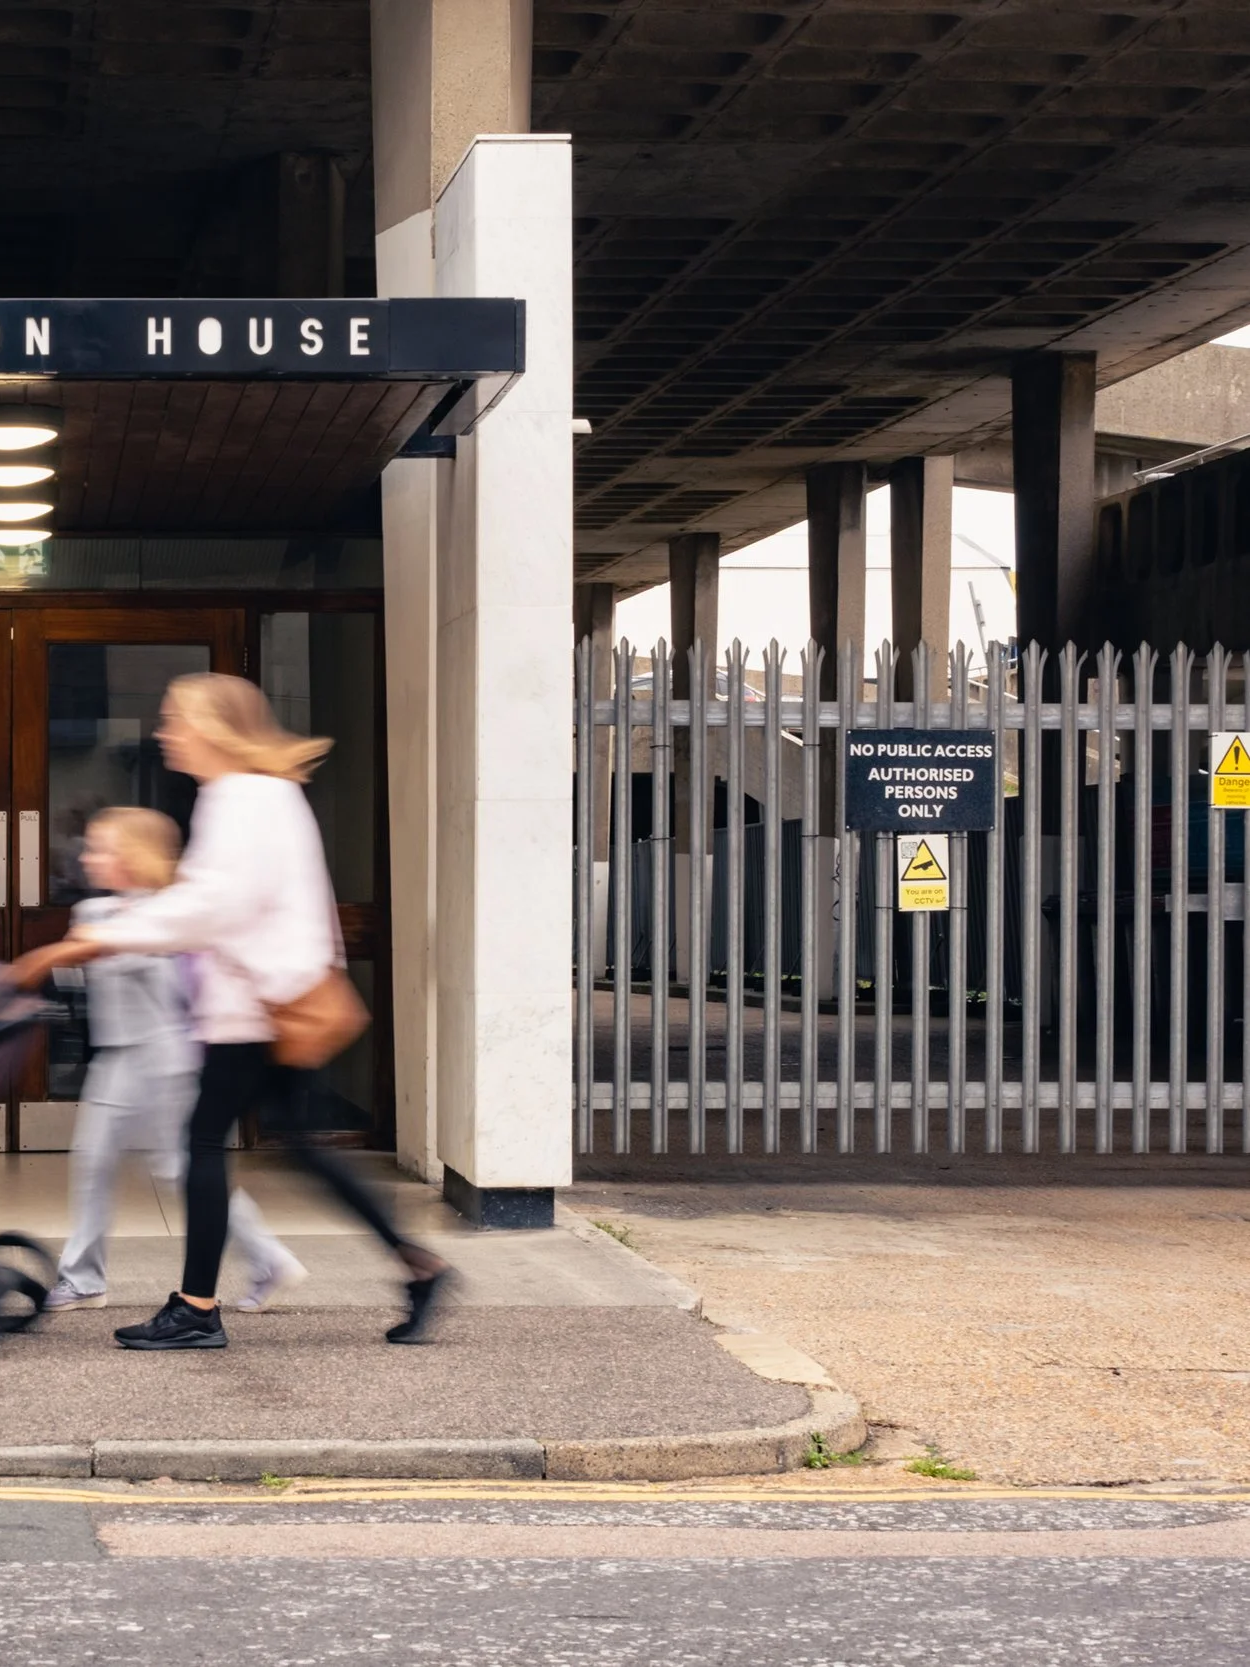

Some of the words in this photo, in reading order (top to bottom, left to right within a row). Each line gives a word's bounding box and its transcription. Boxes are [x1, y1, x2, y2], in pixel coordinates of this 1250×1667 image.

[148, 317, 370, 356] HOUSE
[850, 744, 874, 756] NO
[877, 744, 932, 757] PUBLIC
[934, 745, 992, 757] ACCESS
[868, 768, 974, 782] AUTHORISED
[1219, 777, 1250, 788] Dange
[885, 786, 958, 799] PERSONS
[898, 804, 944, 818] ONLY
[20, 815, 38, 823] PULL
[914, 897, 935, 905] CCTV
